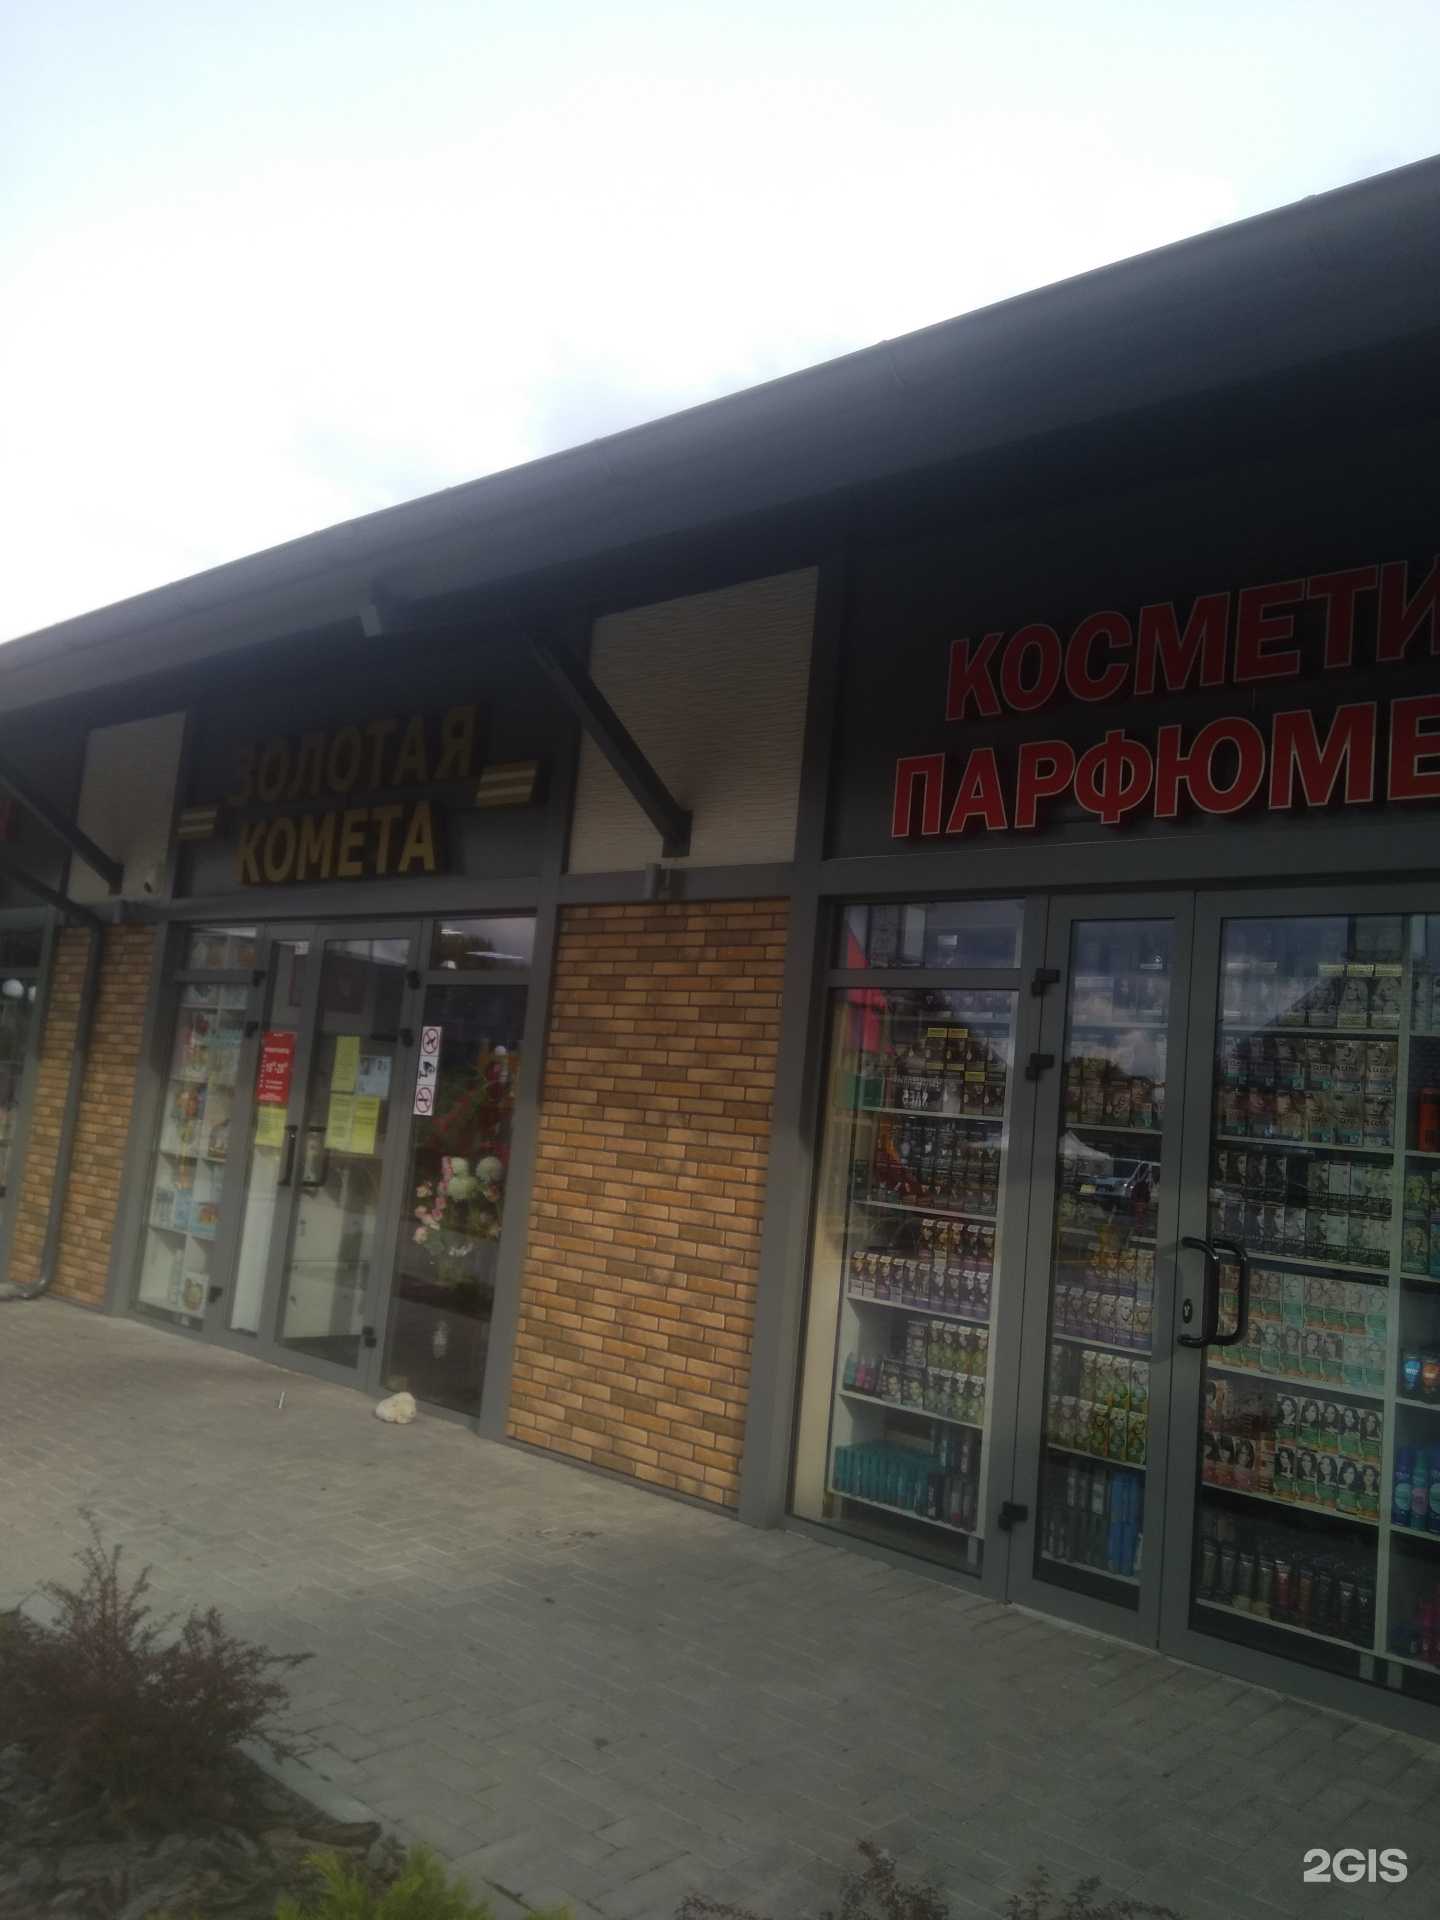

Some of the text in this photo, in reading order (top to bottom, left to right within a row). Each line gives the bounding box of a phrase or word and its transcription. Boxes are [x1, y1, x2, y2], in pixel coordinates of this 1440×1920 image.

[945, 554, 1440, 721] КОСМЕТИ
[227, 703, 479, 804] ЗОЛОТАЯ
[891, 693, 1440, 838] ПАРФЮМЕ
[233, 801, 437, 886] КОМЕТА
